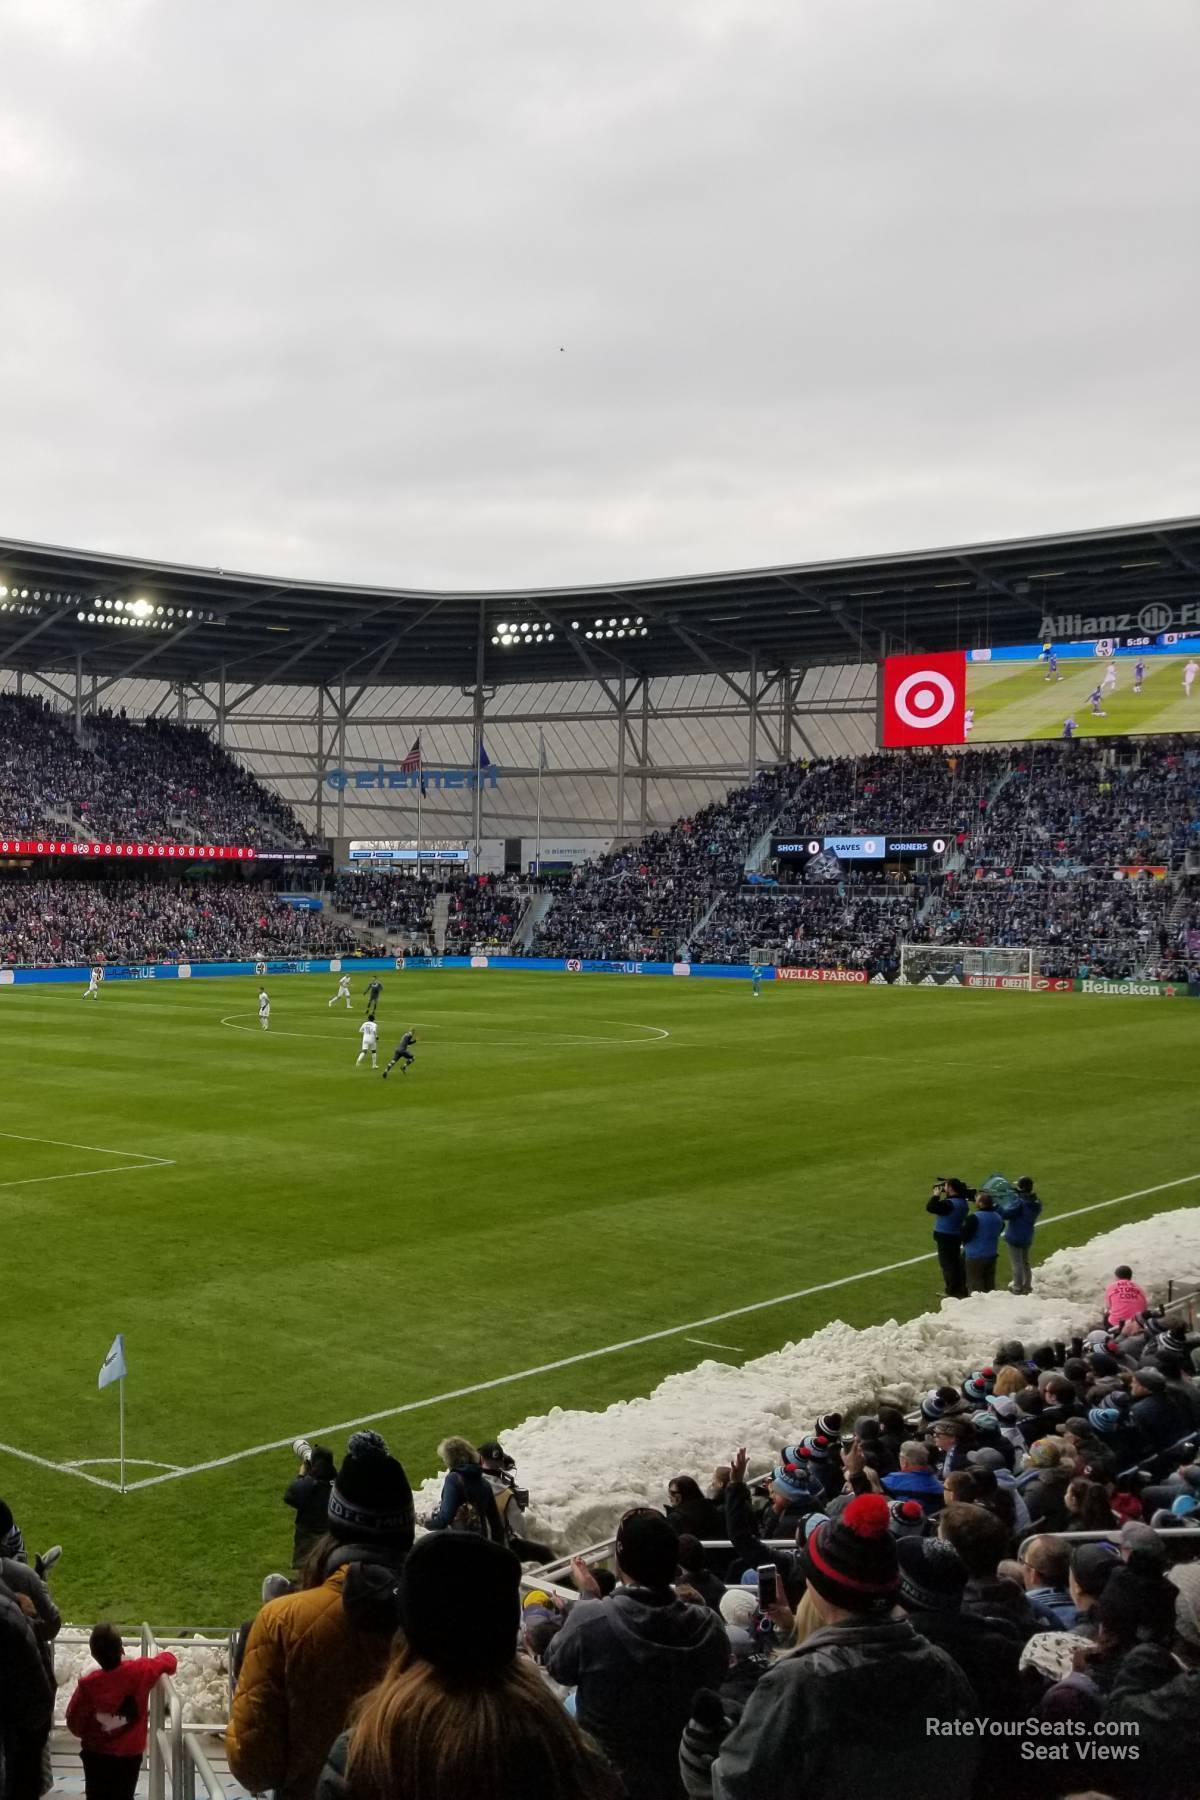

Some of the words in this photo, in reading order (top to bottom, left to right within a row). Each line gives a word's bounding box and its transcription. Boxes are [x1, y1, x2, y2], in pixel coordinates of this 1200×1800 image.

[1038, 614, 1131, 638] Allianz
[1126, 637, 1150, 646] 5:56
[356, 764, 497, 789] element
[808, 841, 820, 855] 0
[889, 843, 928, 851] CORNERS
[932, 840, 946, 853] 0
[778, 969, 819, 980] WELLS
[822, 970, 865, 982] FARGO
[1081, 980, 1160, 996] Heineken
